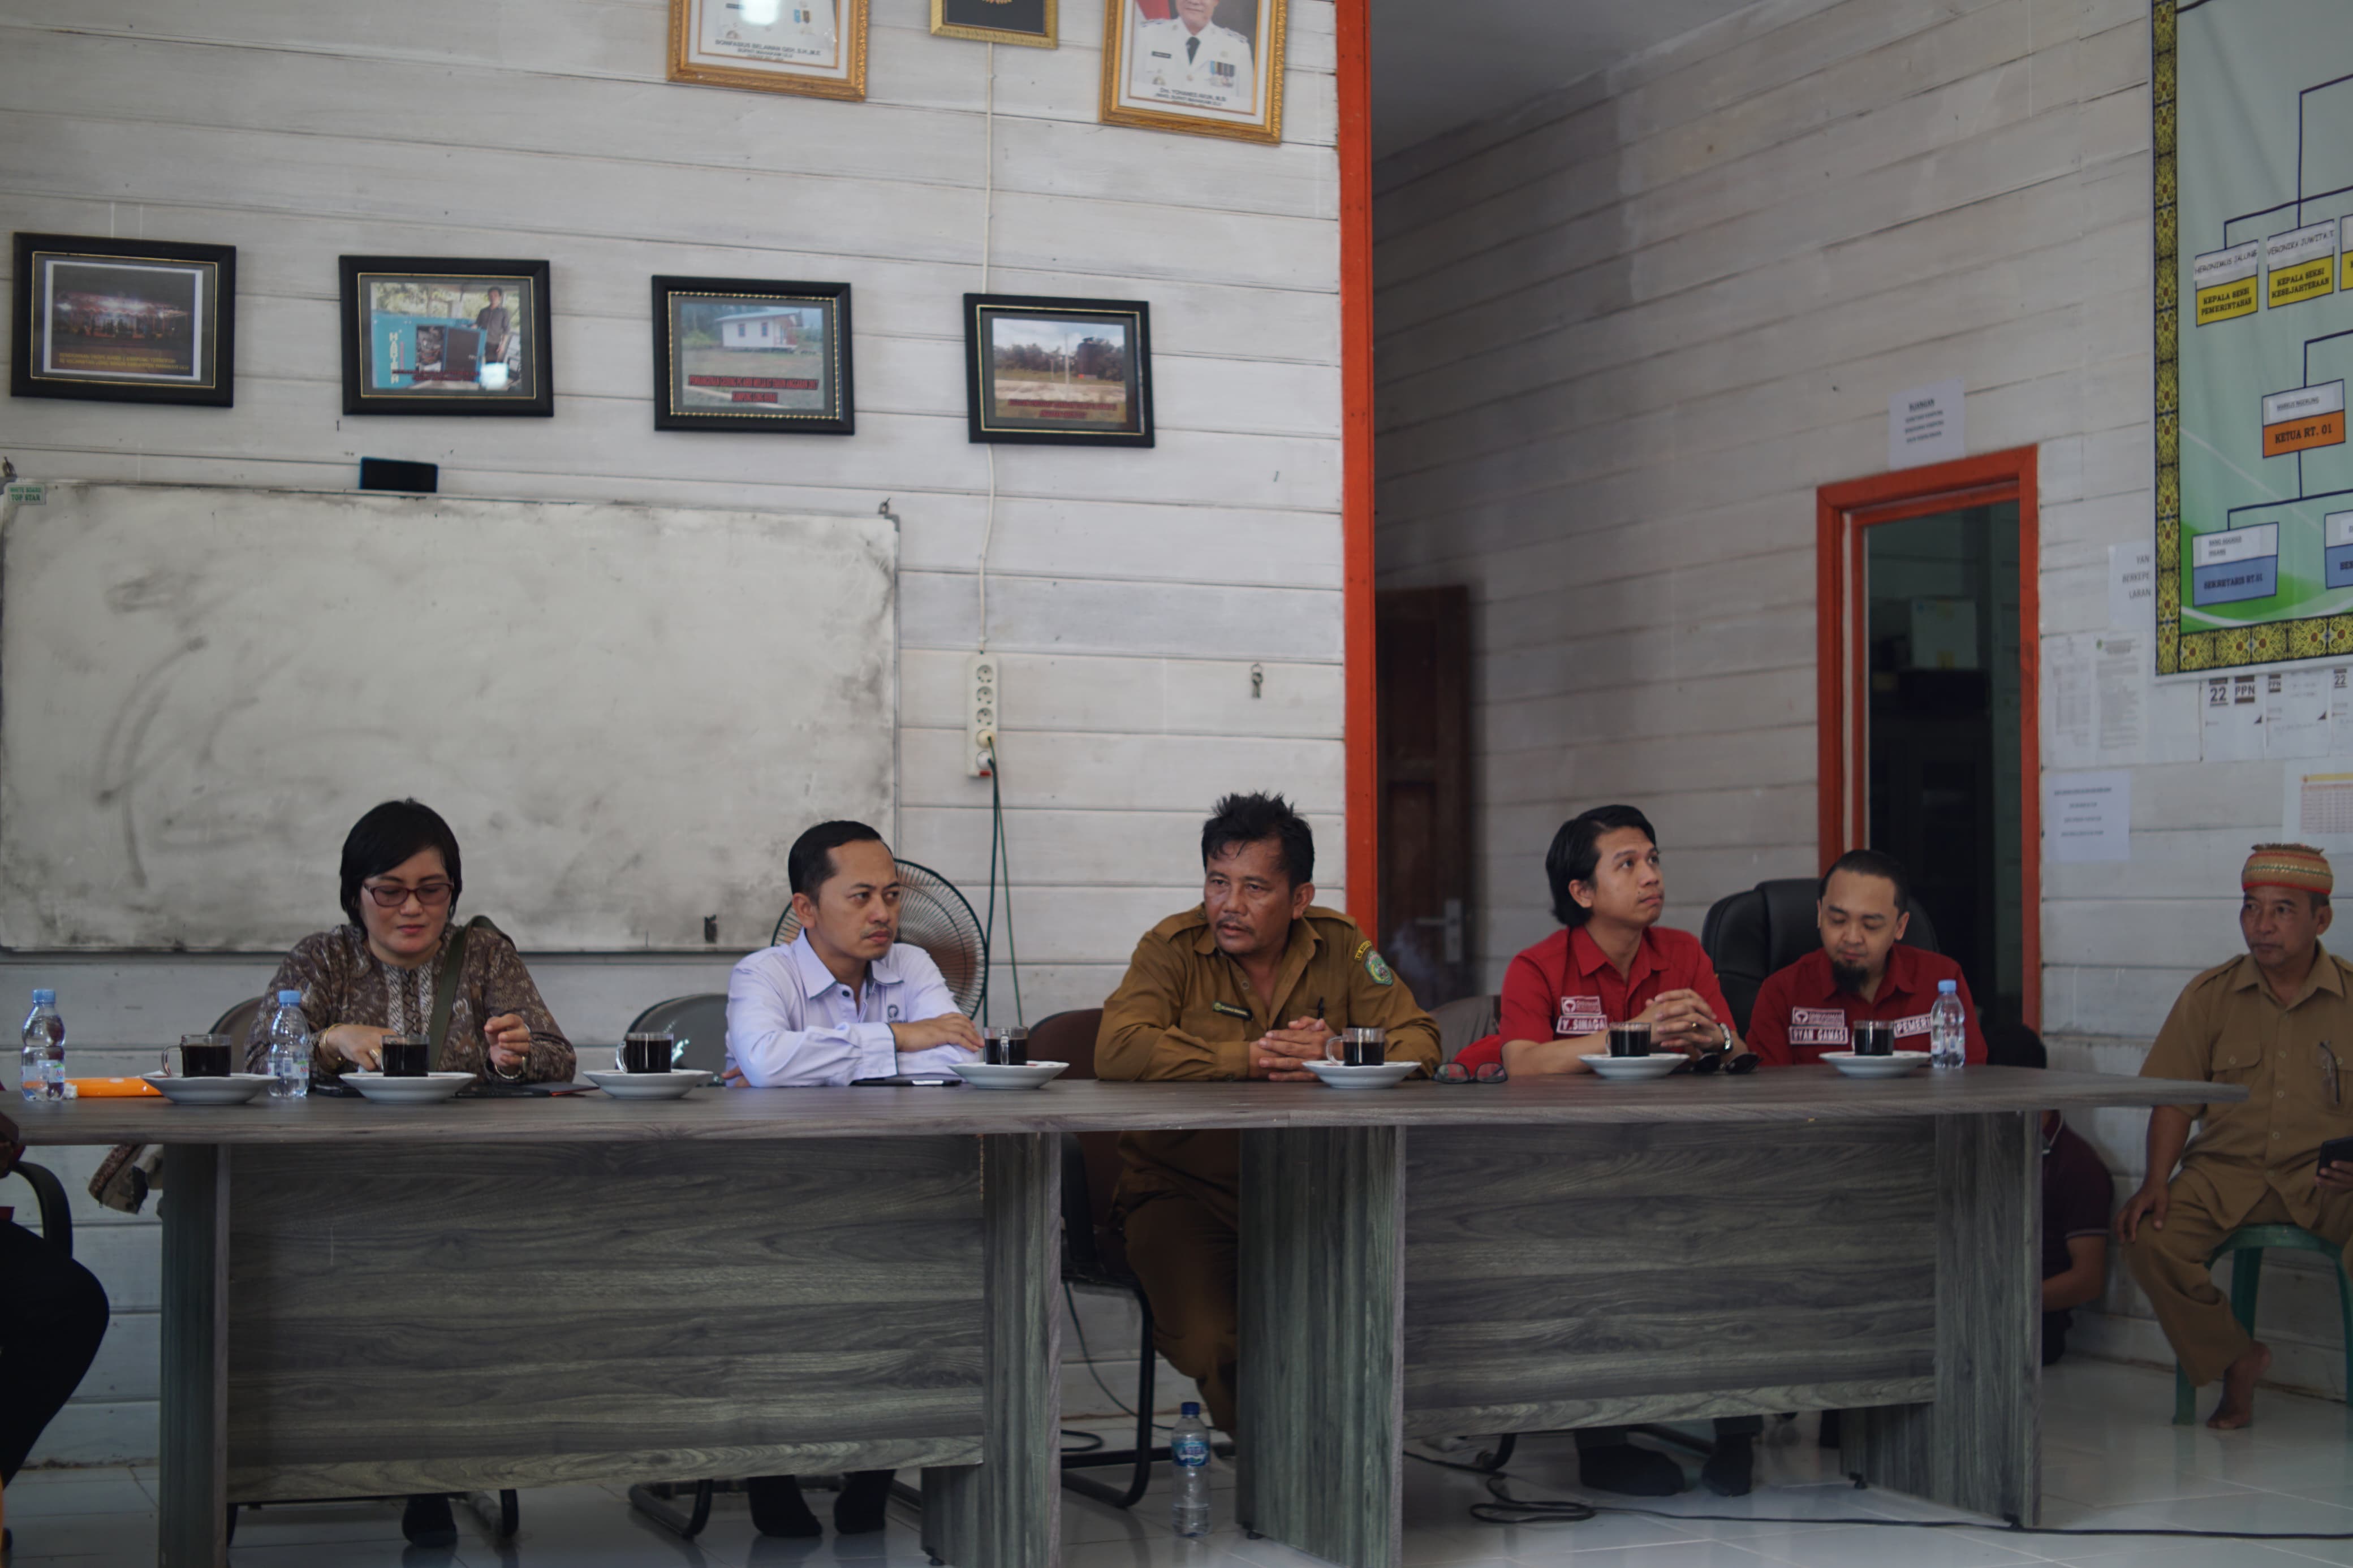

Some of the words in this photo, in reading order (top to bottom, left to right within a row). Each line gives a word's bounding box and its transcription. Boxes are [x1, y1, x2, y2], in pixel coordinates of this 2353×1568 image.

[2277, 276, 2303, 287] KEPALA
[2305, 267, 2325, 279] SEKSI
[2203, 293, 2230, 305] KEPALA
[2232, 287, 2249, 299] SEKSI
[2272, 278, 2329, 299] KESEJAHTERAAN
[2201, 297, 2252, 316] PEMERINTAHAN
[2275, 430, 2302, 444] KETUA
[2304, 426, 2319, 438] RT.
[2321, 424, 2333, 434] 01
[2204, 576, 2245, 589] SEKRETARIS
[2268, 679, 2281, 688] PPN
[2334, 675, 2346, 686] 22
[2210, 686, 2227, 703] 22
[2235, 685, 2255, 696] PPN
